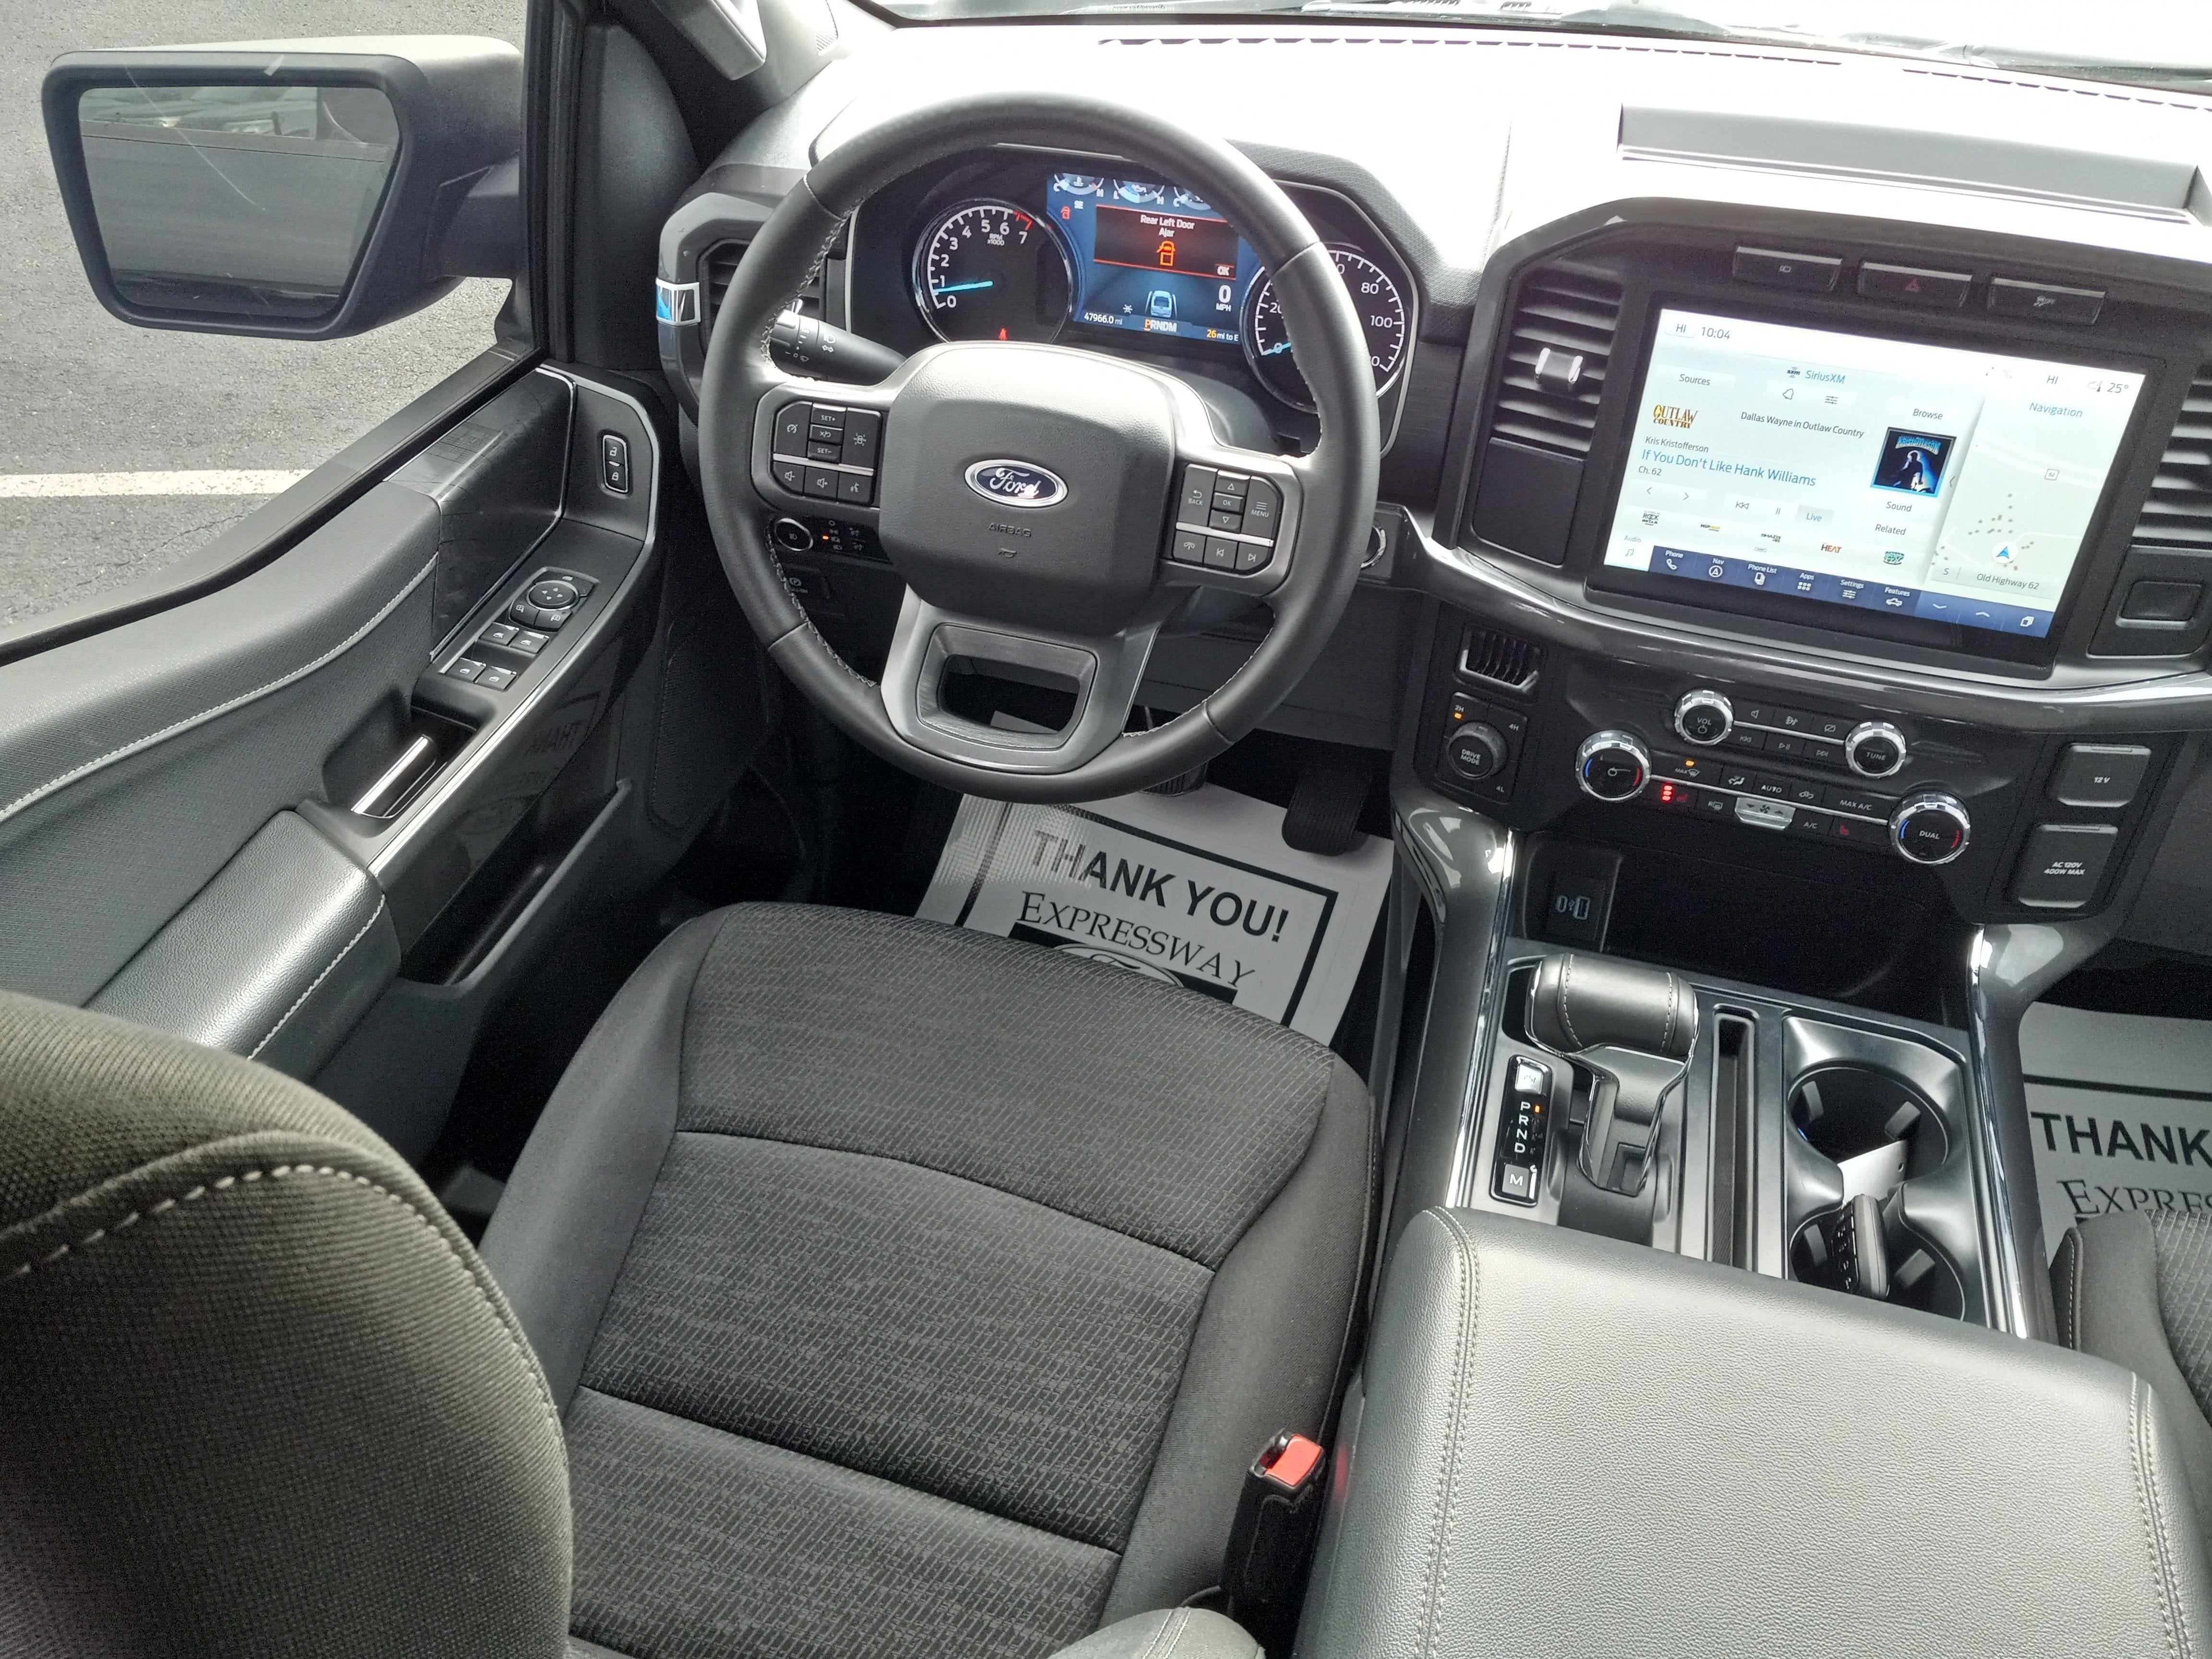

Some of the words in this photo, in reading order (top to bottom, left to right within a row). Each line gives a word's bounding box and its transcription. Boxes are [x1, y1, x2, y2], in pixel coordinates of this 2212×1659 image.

[1074, 200, 1083, 209] SE
[981, 219, 990, 233] 5
[1140, 214, 1158, 225] Rear
[1159, 217, 1175, 228] Left
[1176, 220, 1195, 229] Door
[962, 226, 972, 239] 4
[1000, 222, 1009, 235] 6
[1159, 228, 1175, 238] Ajar
[950, 237, 958, 250] 3
[1019, 231, 1028, 244] 7
[940, 254, 949, 267] 2
[1217, 265, 1229, 276] OK
[940, 276, 945, 287] 1
[1218, 285, 1231, 303] 0
[1361, 282, 1379, 294] 80
[947, 295, 956, 308] 0
[1216, 303, 1231, 312] MPH
[1084, 312, 1114, 325] 47966.0
[1370, 315, 1393, 328] 100
[1206, 329, 1217, 338] 26
[1675, 324, 1686, 333] HI
[1701, 326, 1731, 340] 10:04
[1679, 373, 1711, 386] Sources
[1804, 370, 1846, 384] SiriusXM
[2046, 375, 2059, 385] HI
[2107, 382, 2129, 394] 25°
[1653, 404, 1698, 423] OUTLAW
[1912, 408, 1943, 420] Browse
[2029, 402, 2083, 418] Navigation
[1653, 418, 1692, 429] COUNTRY
[1741, 411, 1765, 422] Dallas
[1766, 415, 1793, 427] Wayne
[1793, 420, 1801, 428] in
[1803, 421, 1832, 433] Outlaw
[1832, 426, 1865, 439] Country
[1645, 436, 1659, 445] Kris
[1660, 438, 1709, 453] Kristofferson
[1638, 466, 1650, 474] Ch.
[1651, 468, 1662, 476] 62
[1642, 449, 1651, 460] If
[1653, 451, 1674, 464] You
[1676, 455, 1707, 469] Don't
[1709, 459, 1732, 473] Like
[1734, 463, 1765, 478] Hank
[1767, 469, 1817, 486] Williams
[989, 468, 1042, 496] Ford
[1188, 498, 1203, 506] BACK
[1886, 502, 1912, 512] Sound
[1251, 509, 1269, 518] MENU
[1806, 513, 1822, 522] Live
[988, 522, 1032, 538] AIRBAG
[1875, 524, 1906, 536] Related
[1665, 550, 1683, 558] Phone
[1821, 544, 1842, 553] HEAT
[1748, 564, 1766, 572] Phone
[1800, 572, 1815, 580] Apps
[1977, 573, 1991, 582] Old
[1992, 576, 2028, 589] Highway
[2028, 581, 2040, 590] 62
[1840, 579, 1864, 589] Settings
[1884, 587, 1911, 597] Features
[1455, 705, 1464, 713] 2H
[1697, 717, 1712, 726] VOL
[1460, 755, 1480, 765] MODE
[1461, 749, 1481, 760] DRIVE
[1865, 751, 1887, 761] TUNE
[1761, 784, 1782, 793] AUTO
[1839, 799, 1857, 808] MAX
[1857, 803, 1872, 811] A/C
[1803, 821, 1818, 830] A/C
[1919, 830, 1940, 840] DUAL
[1034, 830, 1177, 908] THANK
[1187, 879, 1289, 943] YOU!
[1017, 890, 1256, 989] EXPRESSWAY
[1520, 1101, 1531, 1111] P
[1519, 1114, 1529, 1126] R
[1516, 1129, 1527, 1141] N
[2031, 1111, 2212, 1168] THANK
[1515, 1142, 1526, 1153] D
[1510, 1174, 1523, 1186] M
